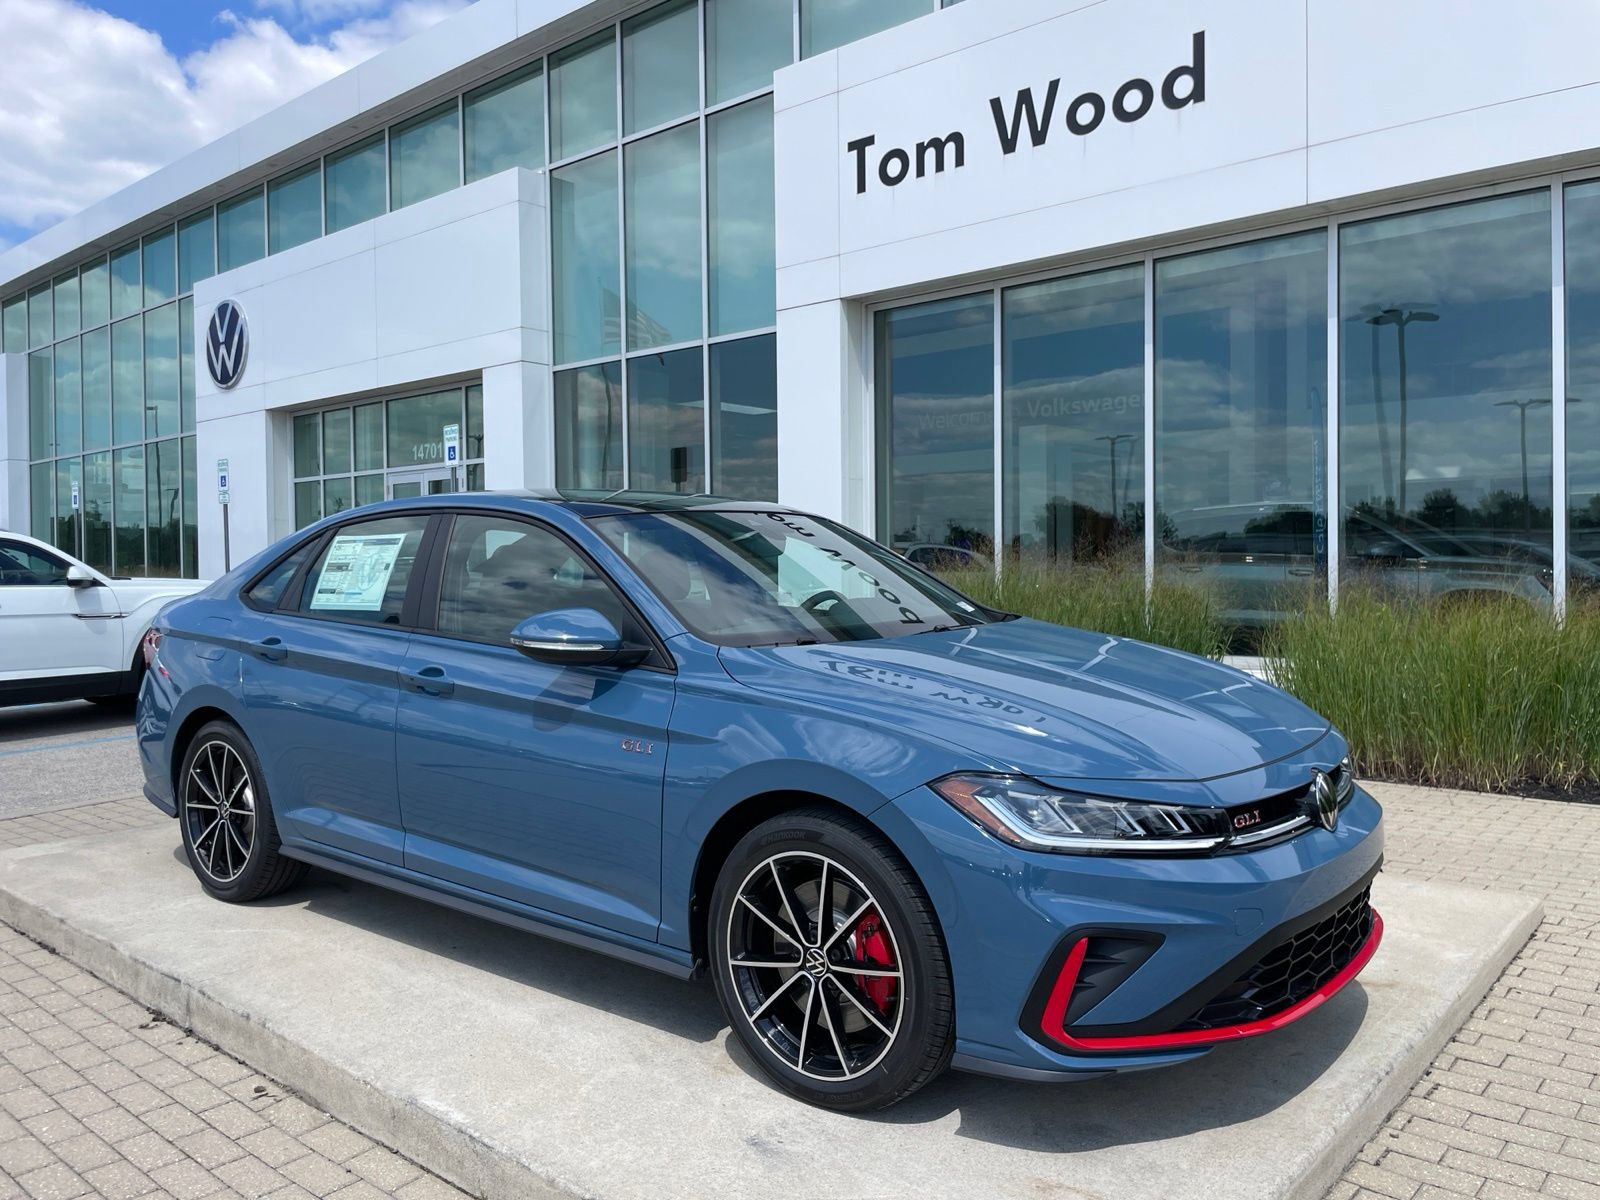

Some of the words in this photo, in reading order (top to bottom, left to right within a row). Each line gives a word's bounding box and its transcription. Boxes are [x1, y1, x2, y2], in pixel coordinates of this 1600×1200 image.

[847, 131, 965, 195] Tom
[988, 30, 1206, 155] Wood
[207, 301, 243, 381] VW
[1027, 394, 1143, 418] Volkswage
[412, 441, 443, 461] 14701
[622, 738, 654, 755] GLI
[1234, 809, 1261, 828] GLI
